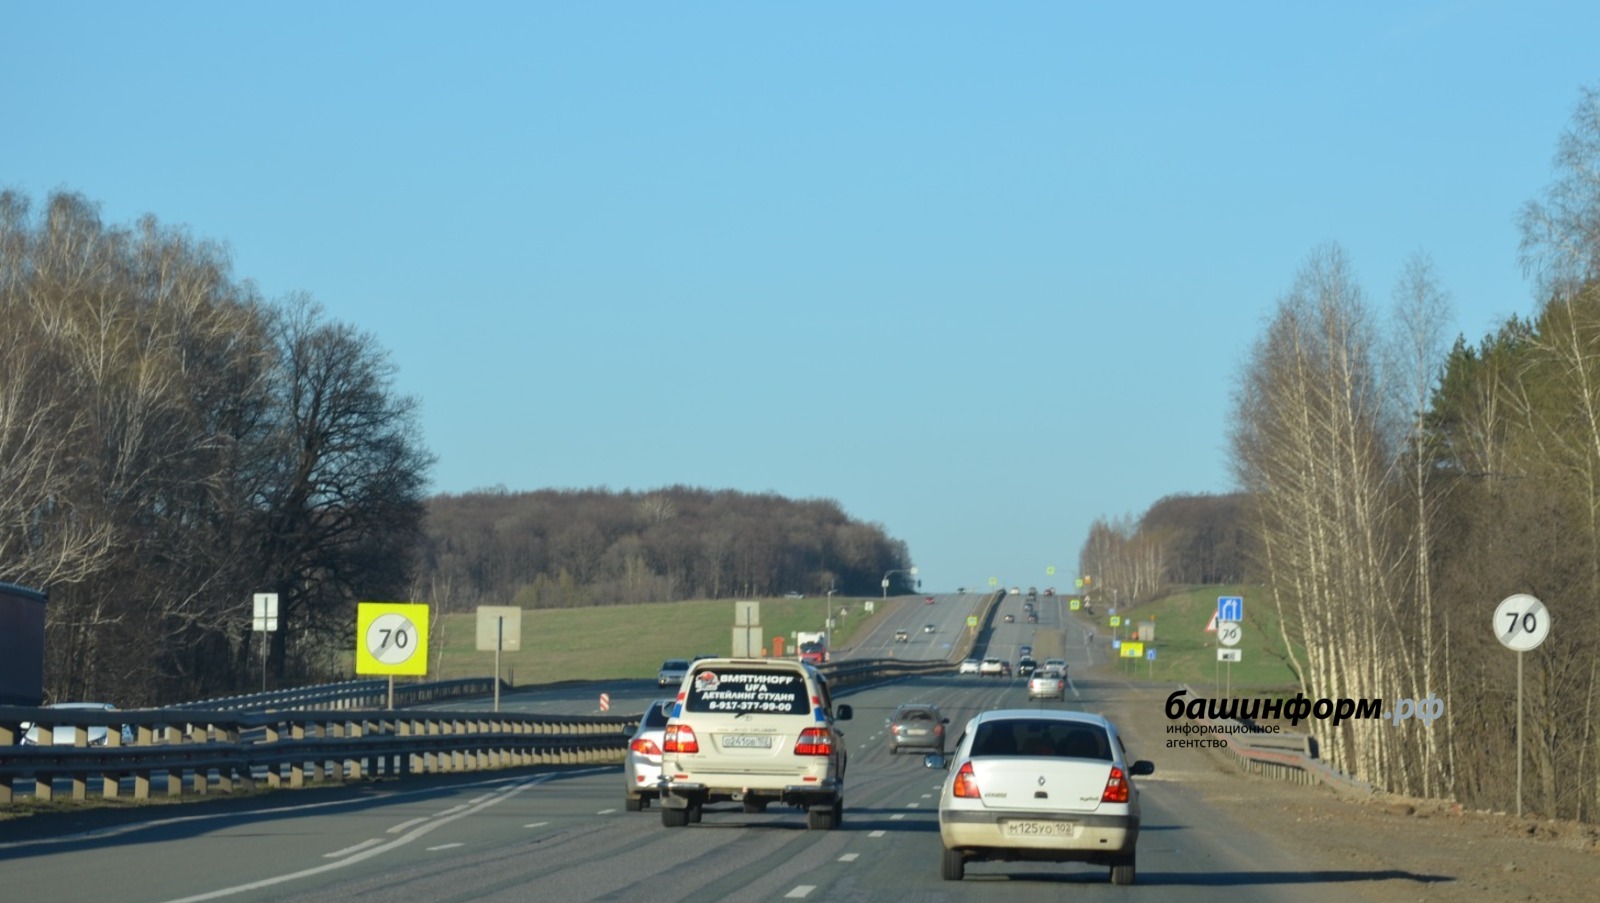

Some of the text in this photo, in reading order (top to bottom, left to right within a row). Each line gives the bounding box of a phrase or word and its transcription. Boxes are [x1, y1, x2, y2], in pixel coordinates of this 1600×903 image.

[1506, 612, 1537, 634] 70
[378, 629, 409, 649] 70
[1223, 628, 1237, 639] 70
[744, 684, 768, 692] UFA
[702, 691, 795, 702] ДЕТЕЙЛИНГ СТУДИЯ
[1055, 823, 1072, 833] 102
